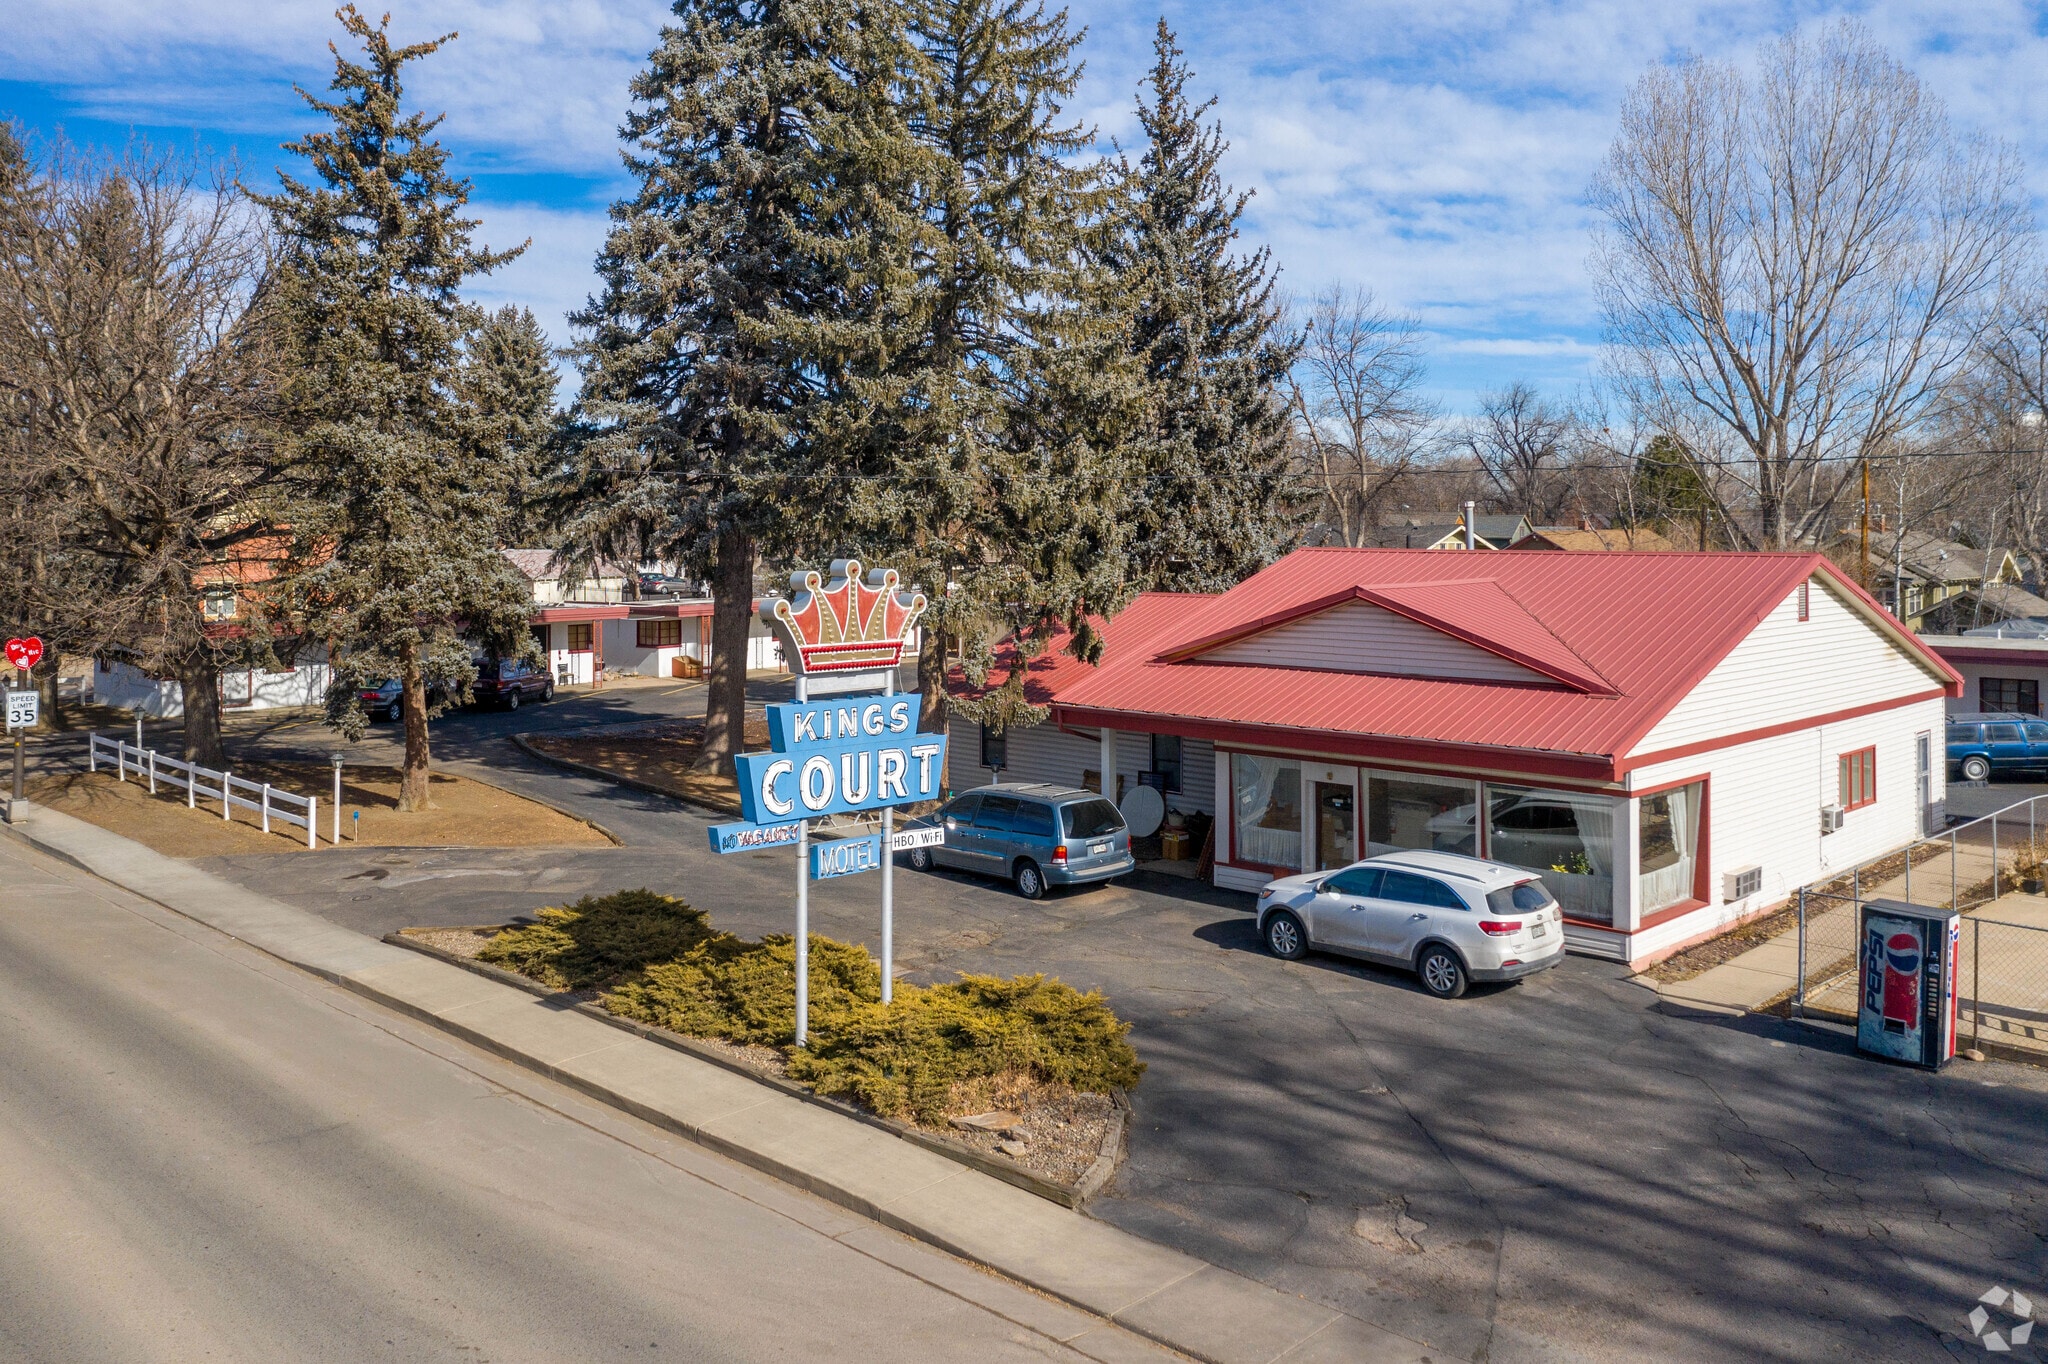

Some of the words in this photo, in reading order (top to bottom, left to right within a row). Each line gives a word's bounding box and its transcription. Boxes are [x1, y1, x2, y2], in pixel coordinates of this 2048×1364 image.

[10, 710, 35, 723] 35
[794, 702, 909, 743] KINGS
[761, 745, 940, 815] COURT
[737, 823, 799, 847] VACANCY
[894, 835, 914, 847] HBO
[821, 841, 878, 876] MOTEL
[1866, 929, 1885, 1015] PEPSI
